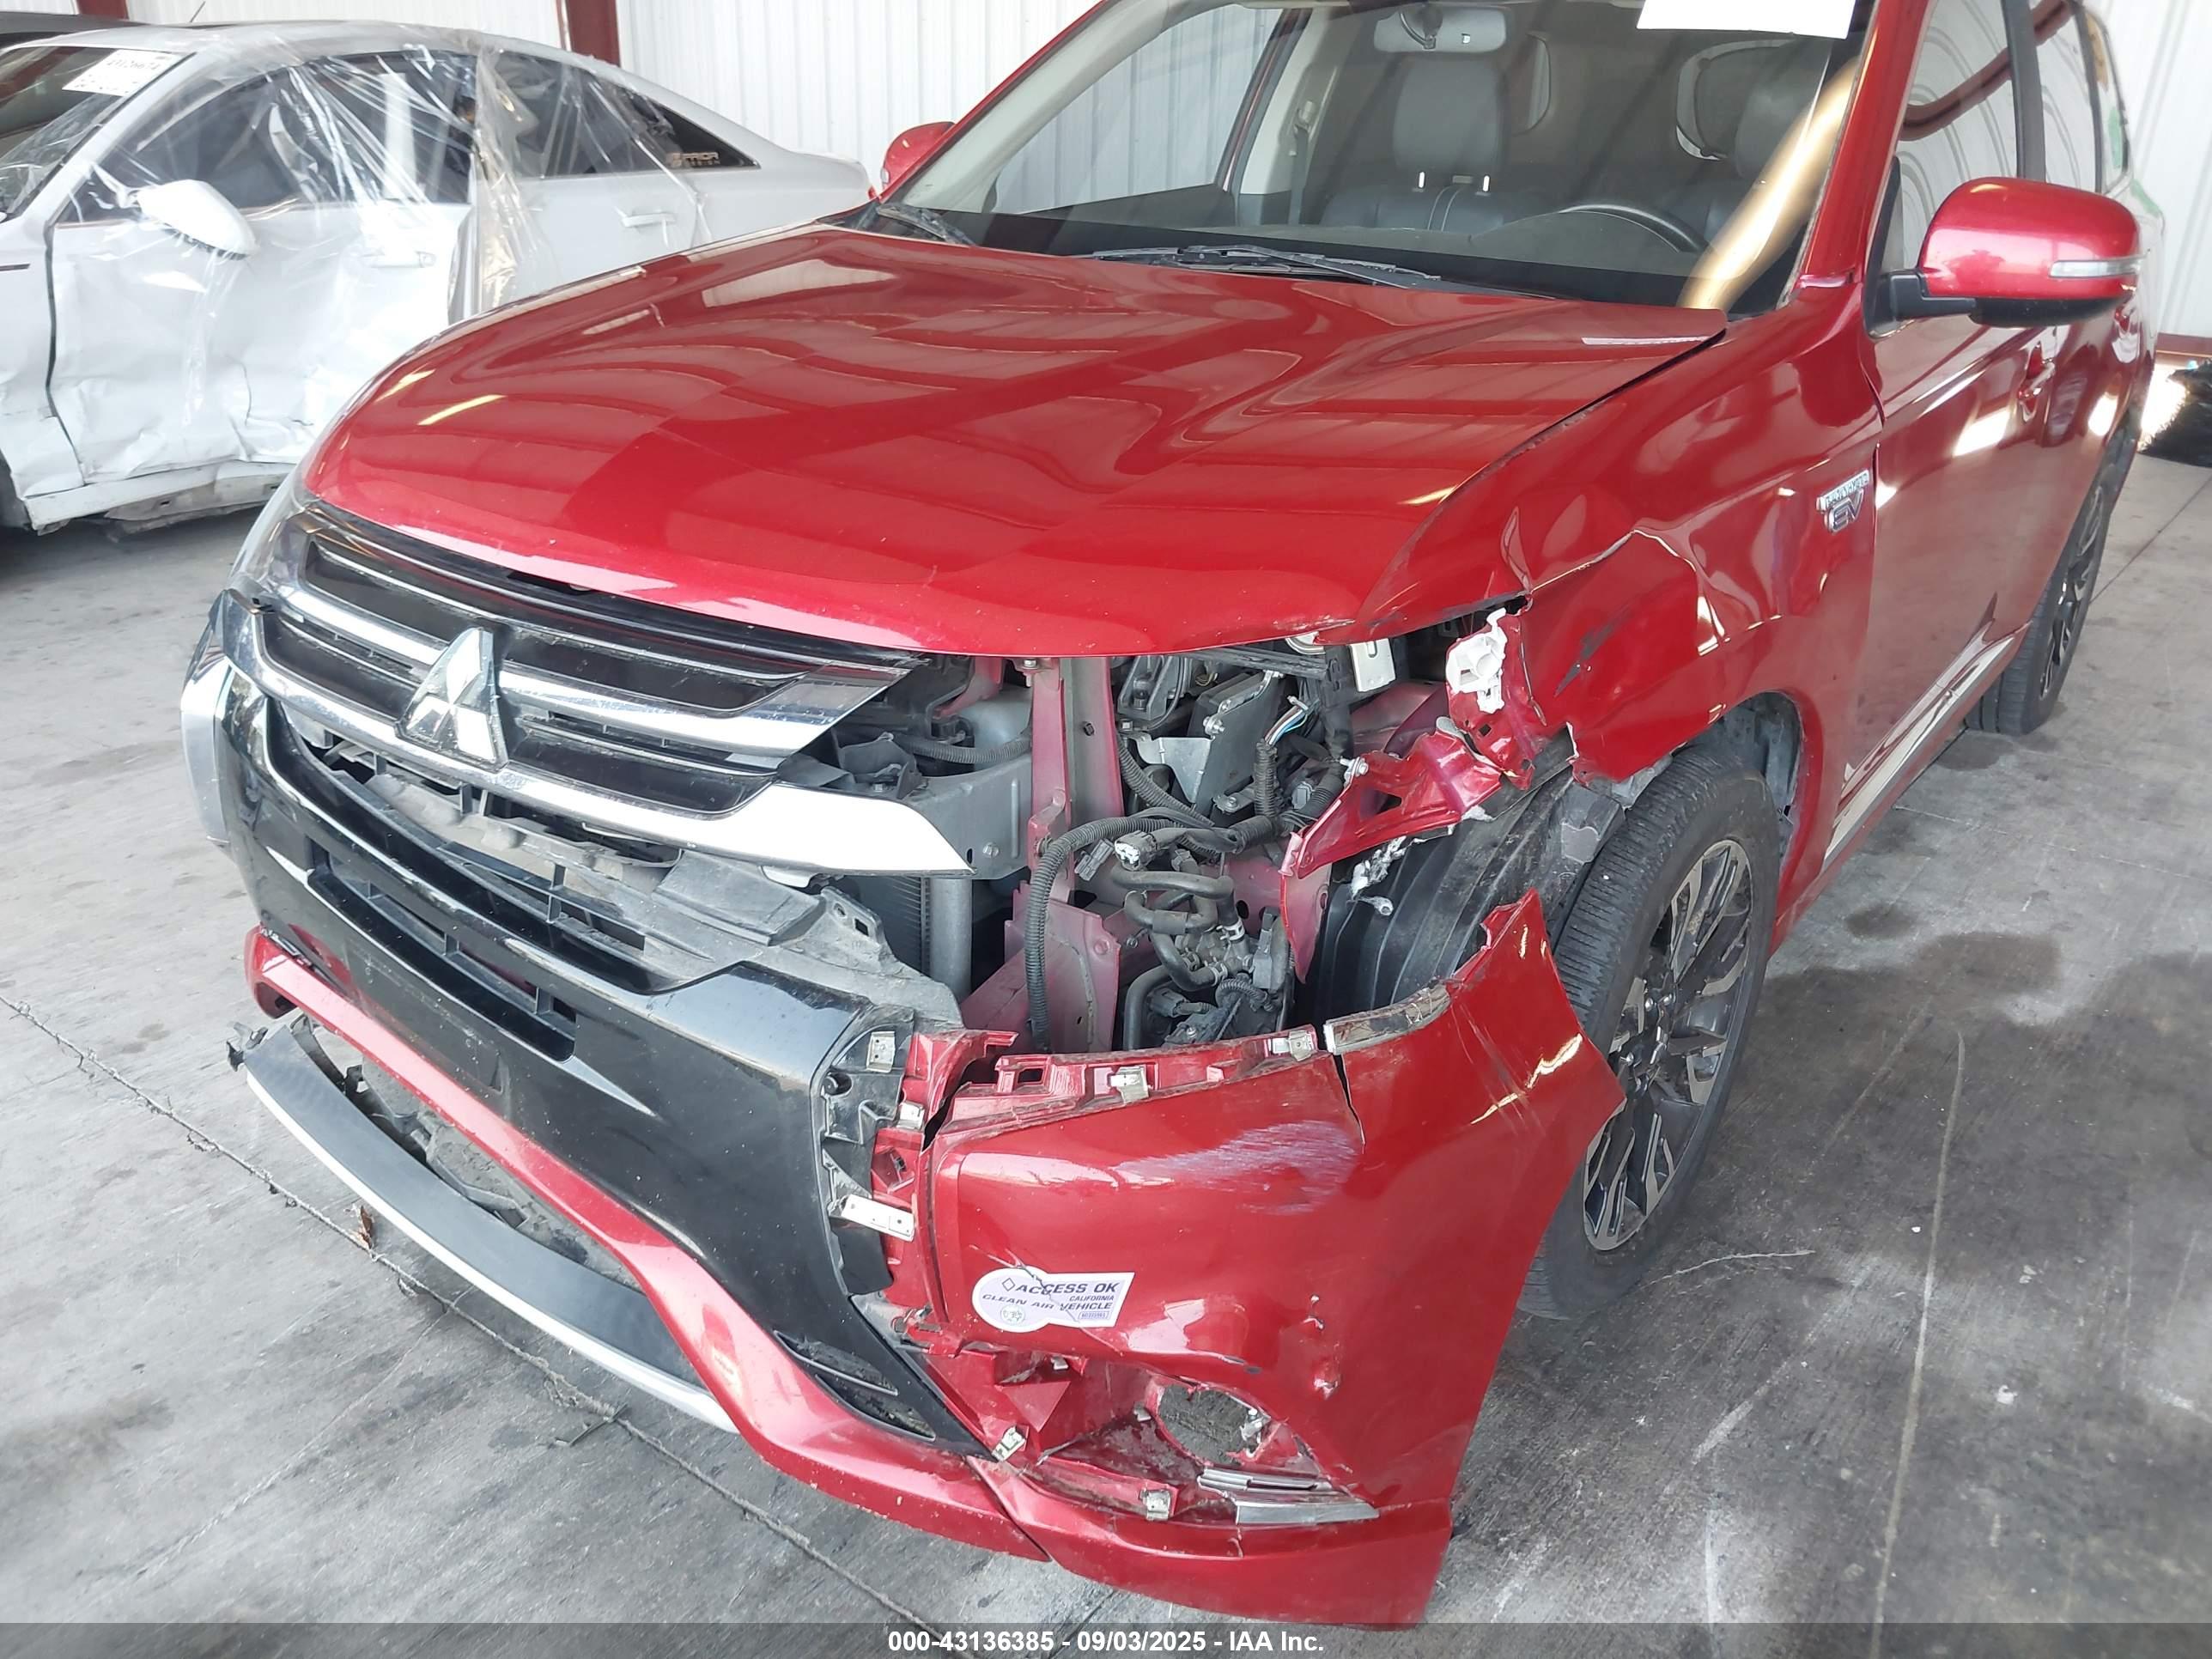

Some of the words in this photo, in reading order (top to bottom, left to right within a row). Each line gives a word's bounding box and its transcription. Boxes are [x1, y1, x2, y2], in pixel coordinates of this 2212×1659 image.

[1826, 489, 1864, 533] EV
[1015, 1283, 1088, 1296] ACCESS
[1093, 1282, 1121, 1293] OK
[981, 1293, 1027, 1305] CLEAN
[1030, 1301, 1054, 1310] AIR
[1060, 1302, 1113, 1311] VEHICLE
